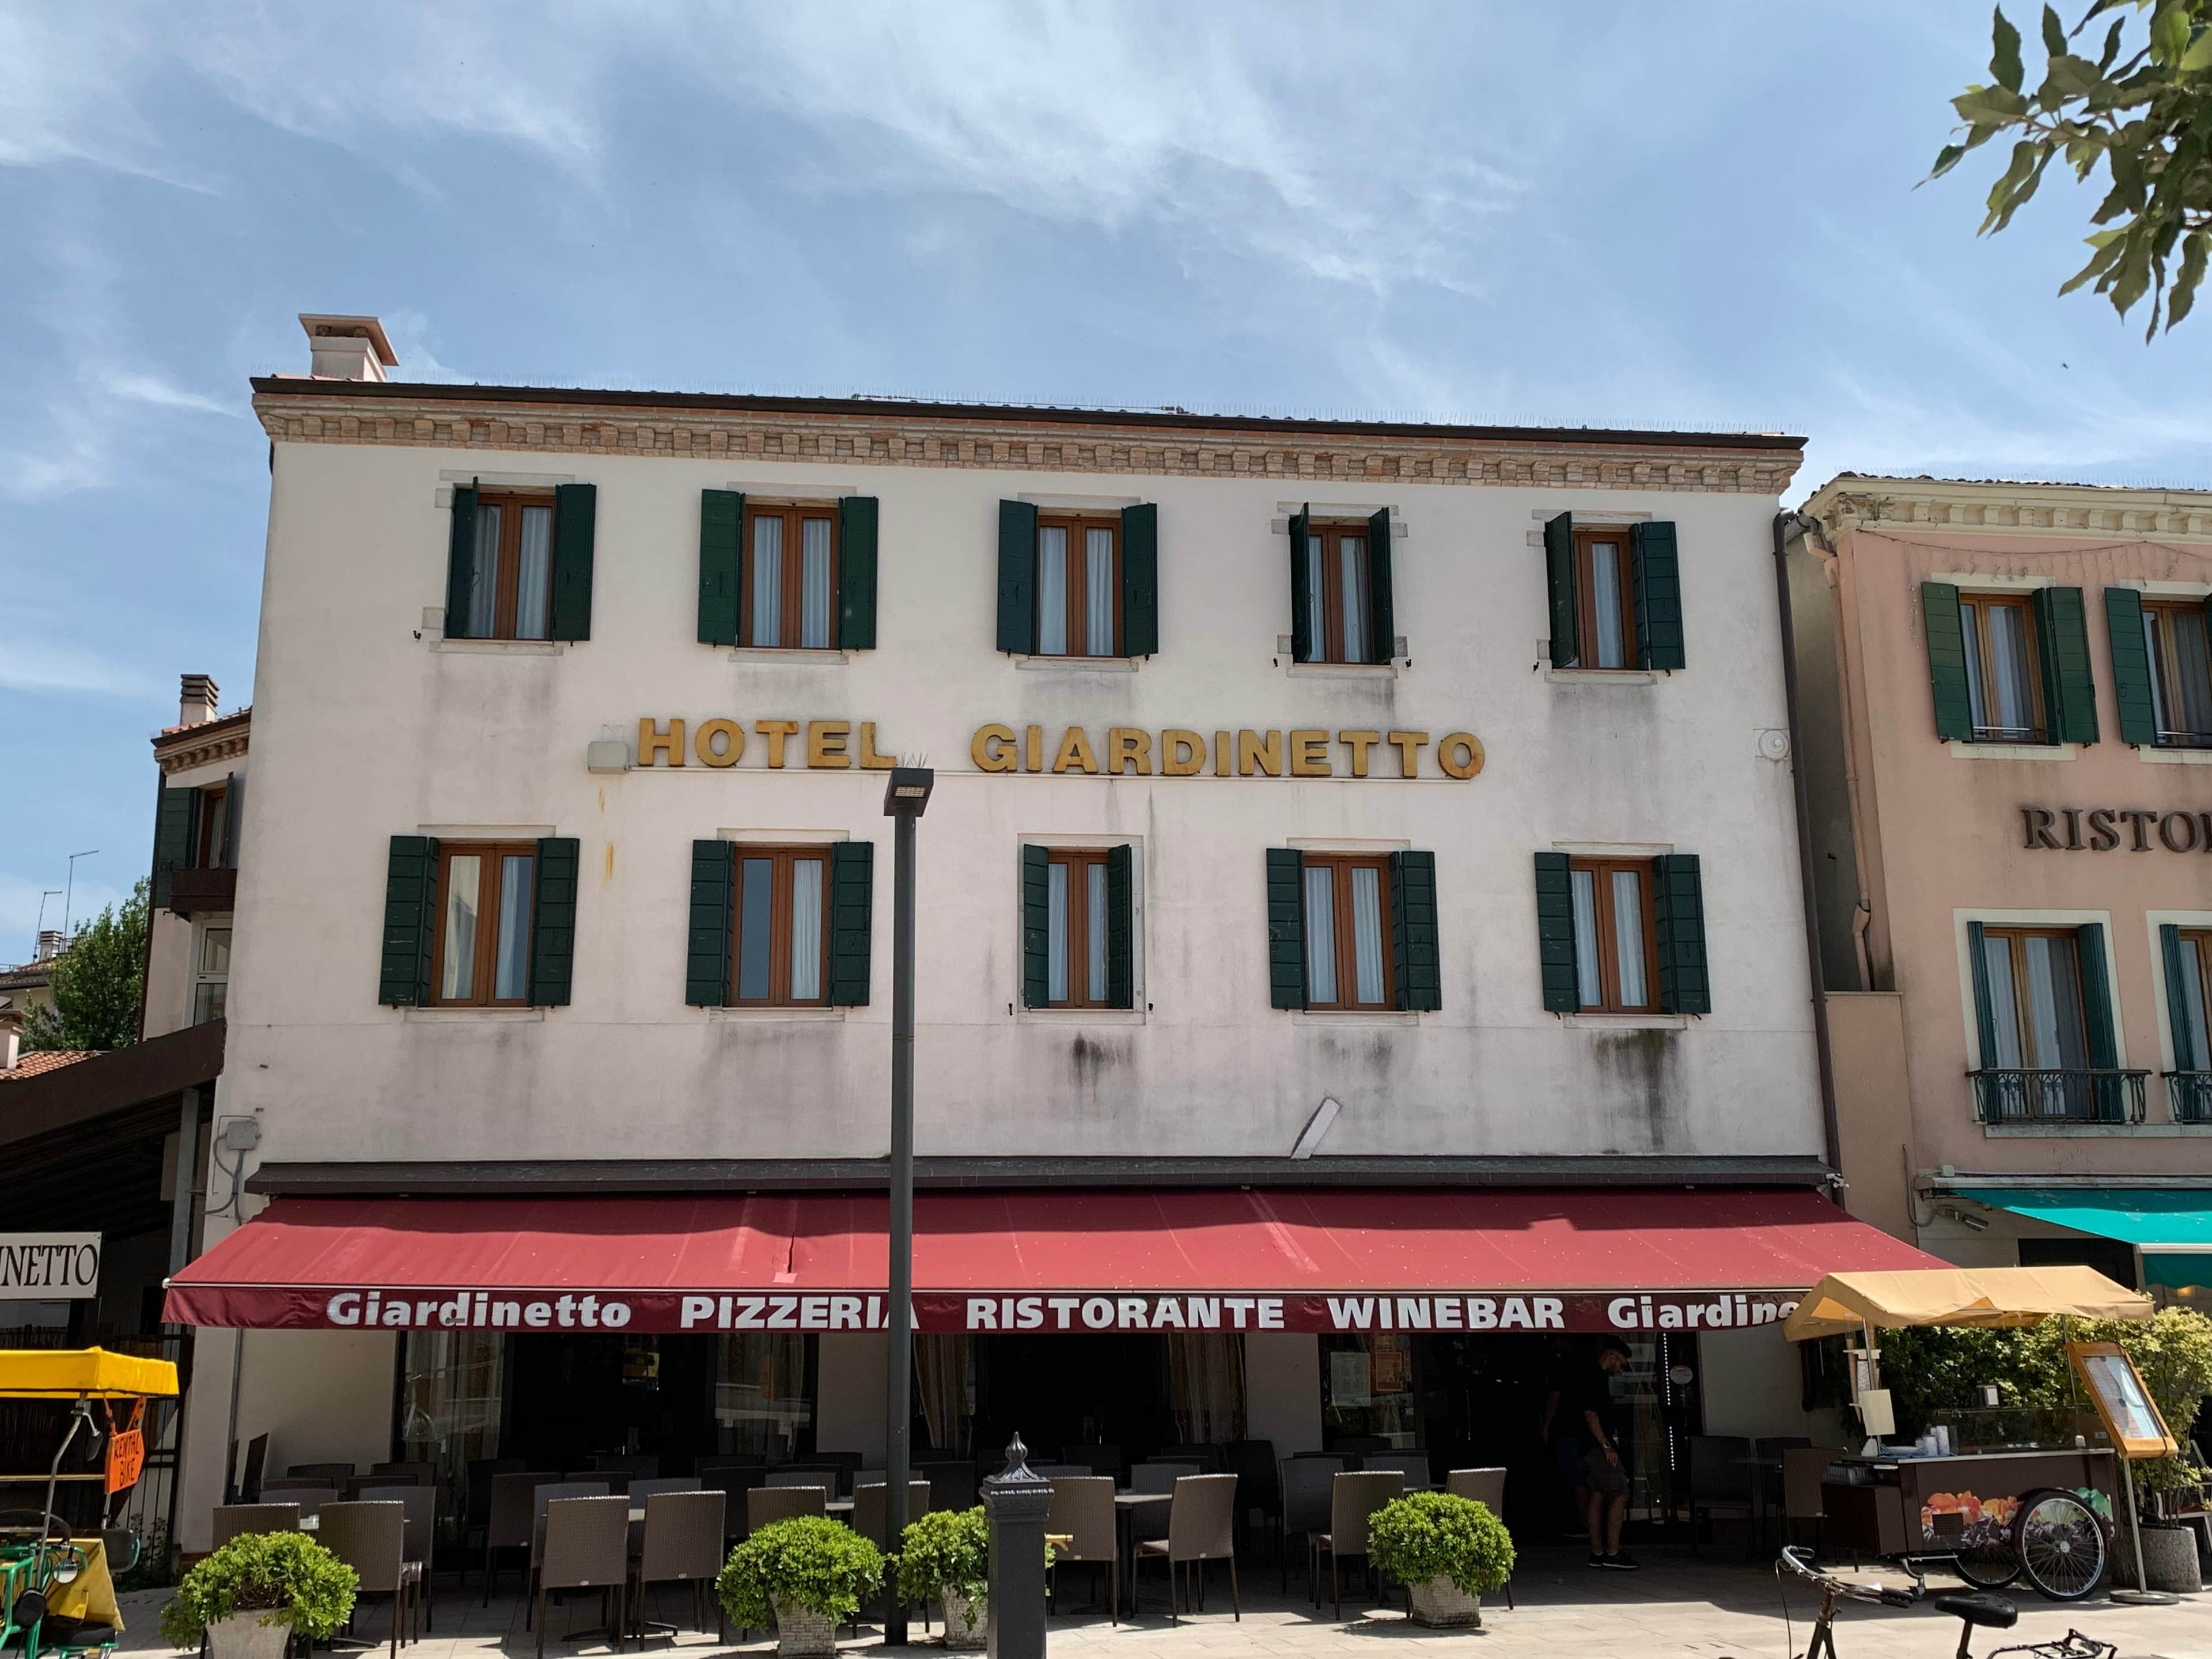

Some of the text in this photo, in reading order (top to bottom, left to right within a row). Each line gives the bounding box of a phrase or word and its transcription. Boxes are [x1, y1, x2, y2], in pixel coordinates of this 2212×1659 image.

[638, 718, 1486, 779] HOTEL GIARDINETTO
[326, 1291, 631, 1328] Giardinetto
[966, 1297, 1285, 1330] RISTORANTE
[1327, 1297, 1565, 1330] WINEBAR
[114, 1432, 139, 1459] RENTAL
[119, 1457, 135, 1486] BIKE
